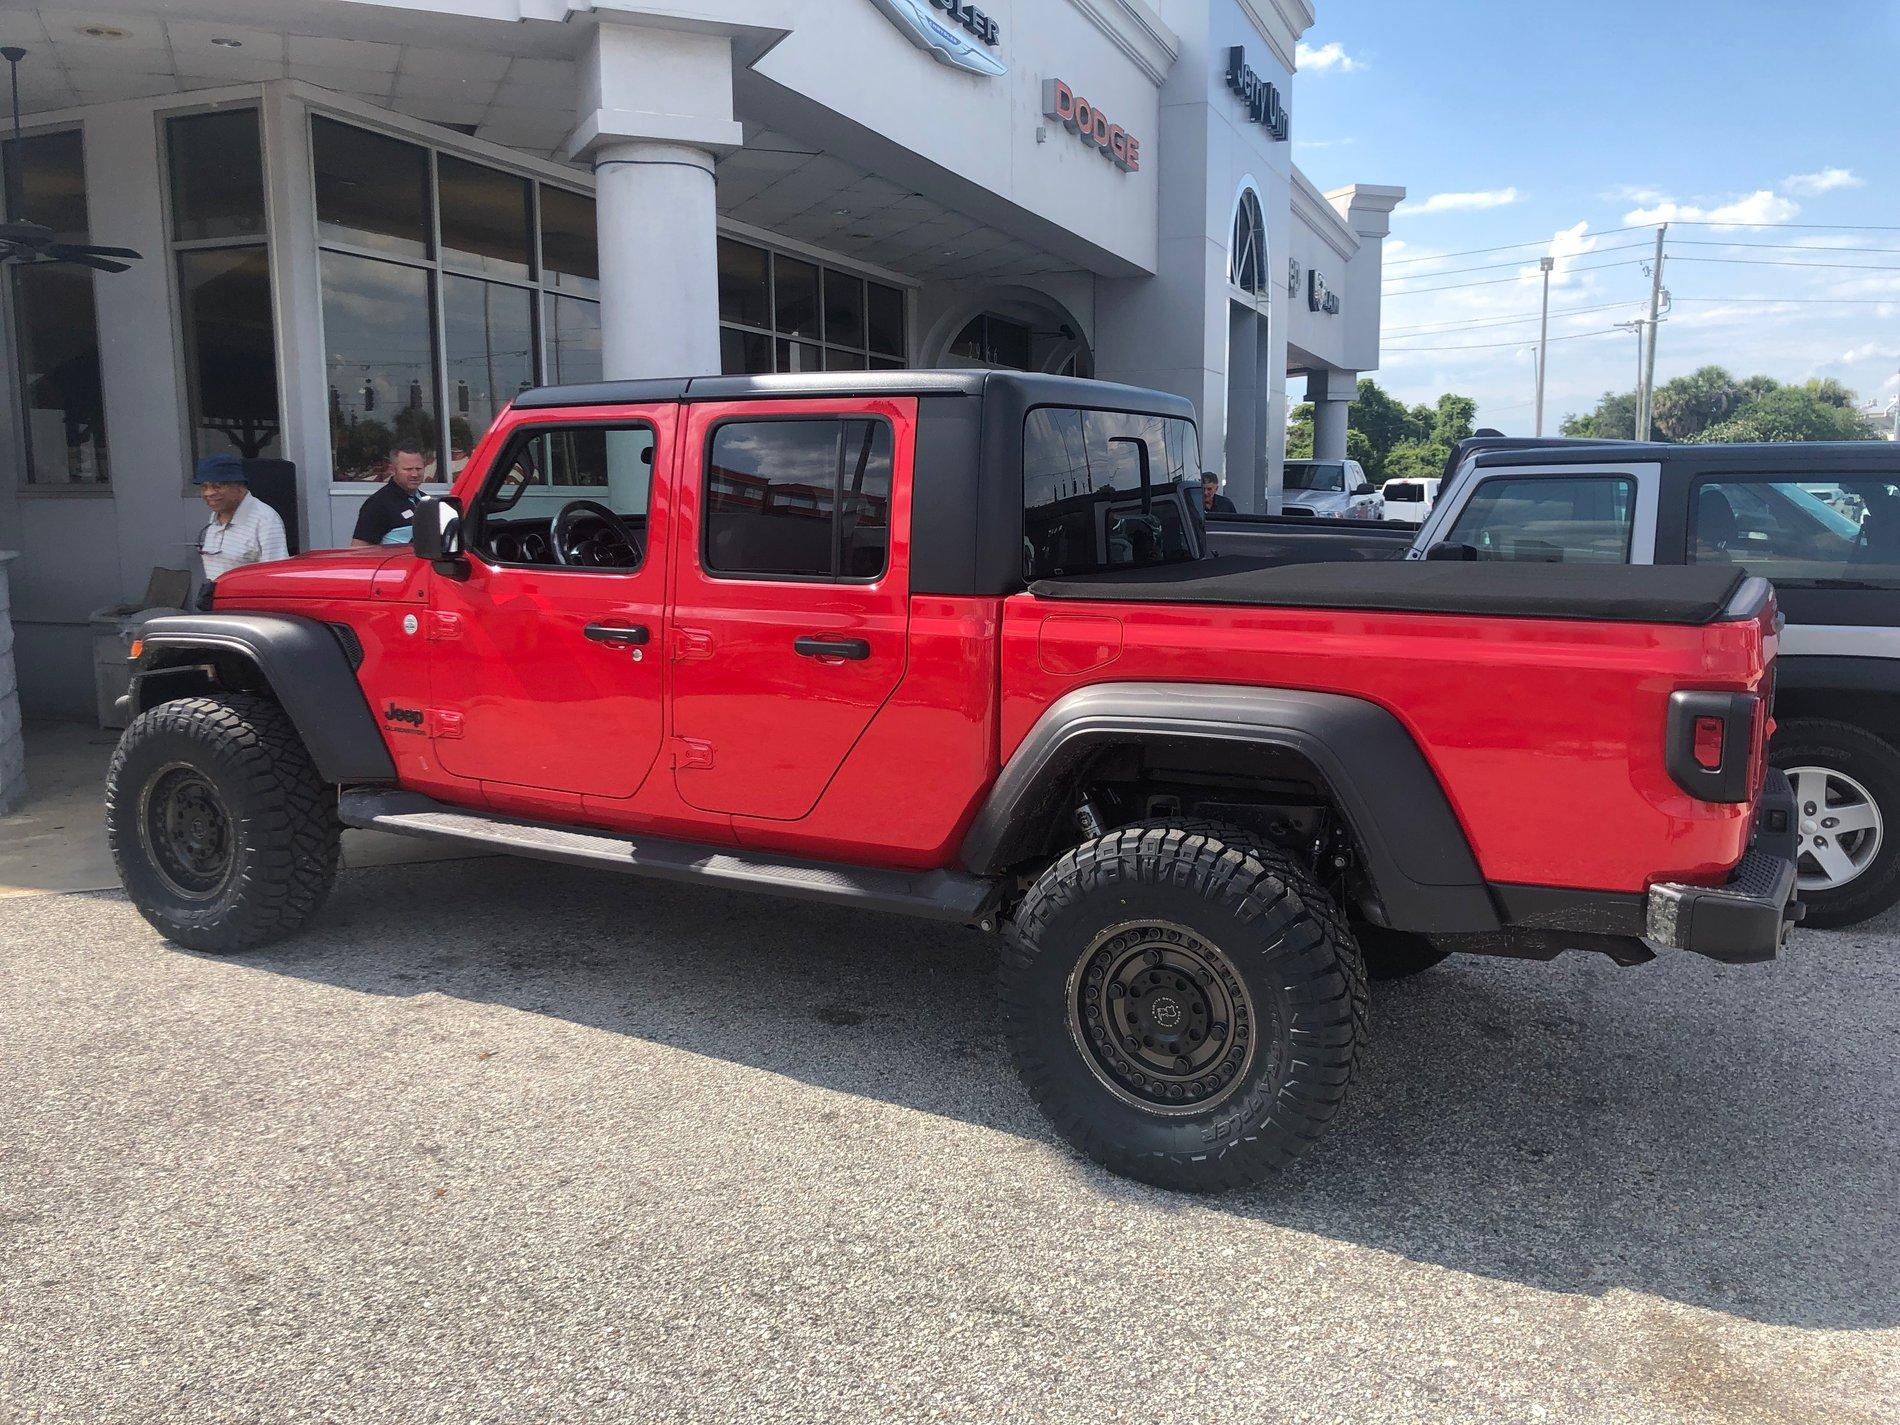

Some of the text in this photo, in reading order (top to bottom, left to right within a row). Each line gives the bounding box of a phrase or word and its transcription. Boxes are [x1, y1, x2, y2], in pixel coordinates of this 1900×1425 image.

[1227, 45, 1267, 125] Jerry
[1042, 78, 1139, 173] DODGE
[385, 703, 424, 727] Jeep
